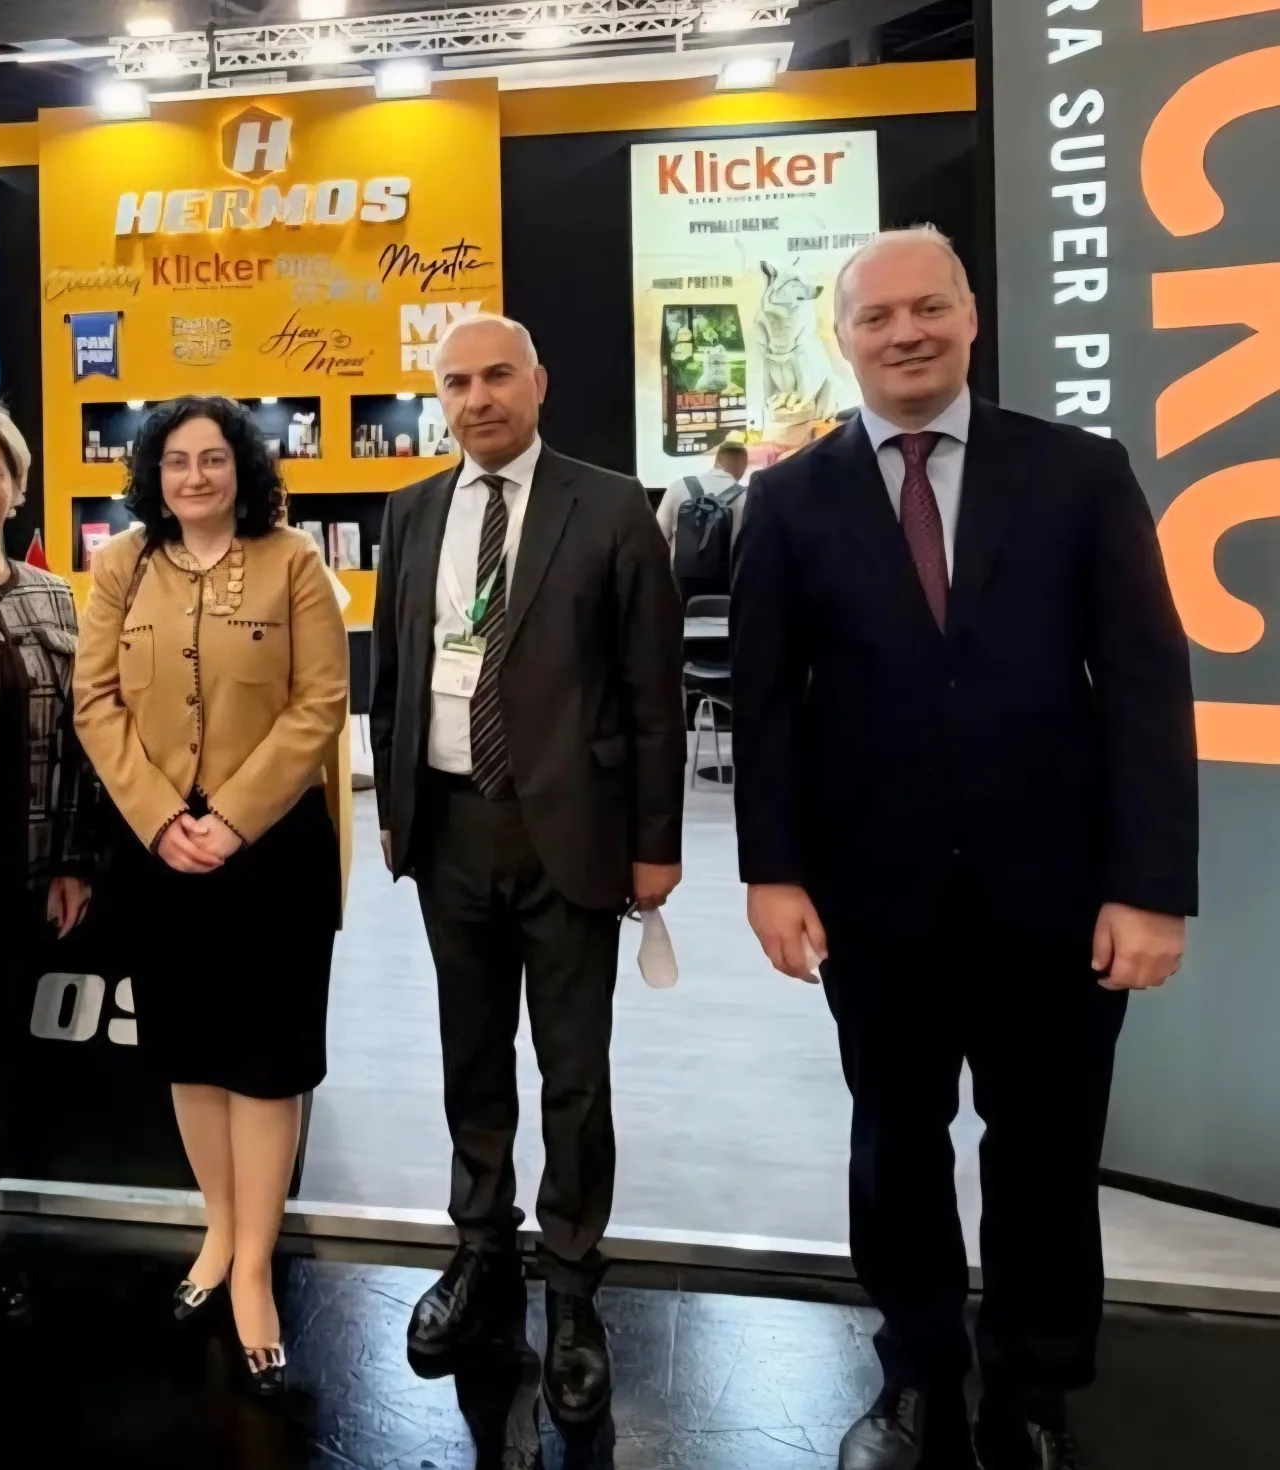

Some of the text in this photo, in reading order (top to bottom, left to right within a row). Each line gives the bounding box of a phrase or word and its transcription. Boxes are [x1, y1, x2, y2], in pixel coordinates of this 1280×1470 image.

[658, 146, 845, 195] Klicker
[1049, 88, 1109, 304] SUPER
[115, 177, 411, 236] HERMOS
[152, 252, 273, 286] Klicker
[379, 238, 494, 292] Mystic
[1054, 333, 1111, 439] PR
